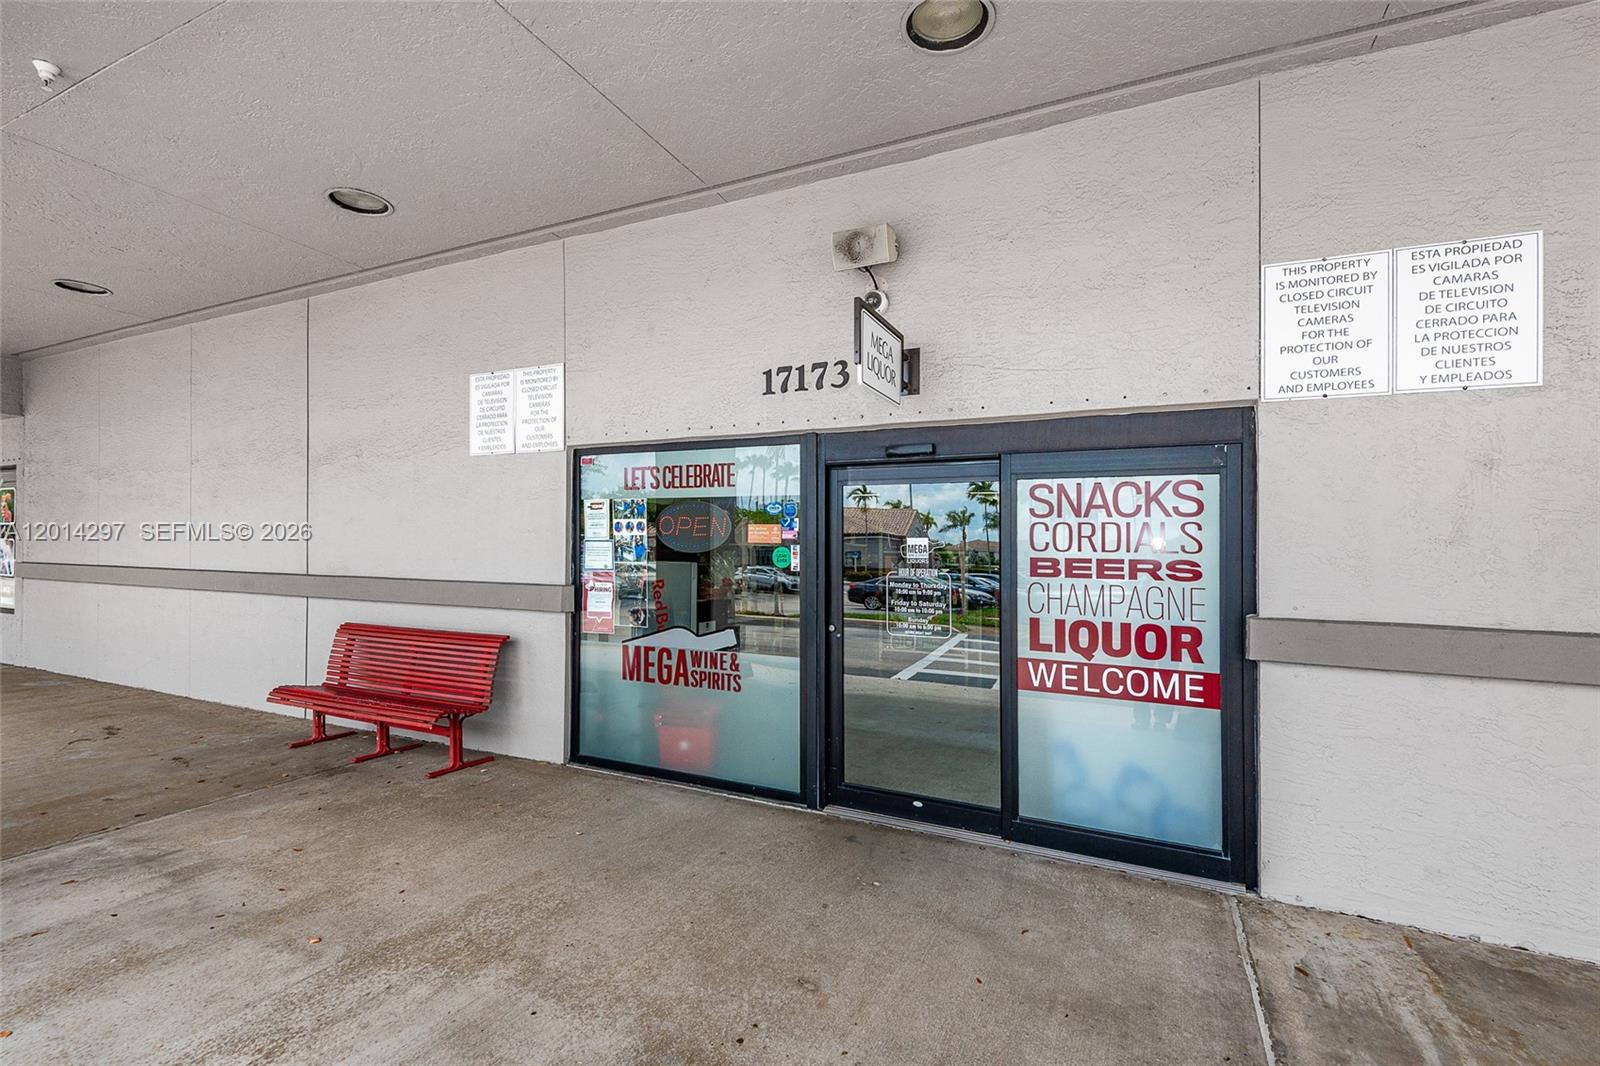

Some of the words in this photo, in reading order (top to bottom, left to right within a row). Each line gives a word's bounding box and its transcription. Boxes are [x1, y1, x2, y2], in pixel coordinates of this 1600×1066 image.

[1411, 249, 1441, 261] ESTA
[1444, 239, 1523, 257] PROPIEDAD
[1282, 266, 1307, 277] THIS
[1310, 258, 1371, 274] PROPERTY
[1411, 264, 1426, 275] ES
[1428, 257, 1491, 273] VIGILADA
[1494, 253, 1523, 265] POR
[1275, 281, 1285, 291] IS
[1288, 273, 1360, 290] MONITORED
[1362, 270, 1378, 281] BY
[1432, 270, 1499, 286] CAMARAS
[1279, 290, 1324, 303] CLOSED
[1327, 284, 1374, 298] CIRCUIT
[1419, 290, 1436, 301] DE
[1438, 282, 1514, 300] TELEVISION
[1294, 299, 1360, 315] TELEVISION
[1424, 304, 1442, 315] DE
[1445, 298, 1508, 312] CIRCUITO
[1297, 313, 1355, 328] CAMERAS
[1415, 315, 1479, 329] CERRADO
[1482, 311, 1518, 324] PARA
[1301, 329, 1325, 340] FOR
[1327, 327, 1350, 338] THE
[1414, 333, 1430, 343] LA
[1433, 326, 1519, 342] PROTECCION
[871, 331, 894, 364] MEGA
[1280, 341, 1353, 355] PROTECTION
[1356, 338, 1373, 349] OF
[1420, 346, 1438, 357] DE
[1441, 340, 1512, 356] NUESTROS
[867, 352, 897, 387] LIQUOR
[1312, 355, 1339, 366] OUR
[1434, 356, 1496, 370] CLIENTES
[762, 360, 850, 396] 17173
[1290, 366, 1362, 381] CUSTOMERS
[1419, 375, 1428, 385] Y
[1431, 369, 1513, 384] EMPLEADOS
[1278, 384, 1304, 394] AND
[1306, 379, 1375, 393] EMPLOYEES
[623, 465, 660, 490] LET'S
[662, 462, 736, 490] CELEBRATE
[1028, 479, 1205, 519] SNACKS
[658, 514, 727, 537] OPEN
[1028, 521, 1204, 555] CORDIALS
[907, 544, 928, 554] MEGA
[1029, 557, 1204, 582] BEERS
[920, 582, 947, 590] Thursday
[919, 600, 947, 609] Saturday
[1027, 581, 1207, 622] CHAMPAGNE
[908, 616, 929, 625] Sunday
[1029, 617, 1205, 664] LIQUOR
[622, 644, 690, 688] MEGA
[690, 650, 728, 671] WINE
[729, 652, 740, 673] &
[690, 670, 742, 693] SPIRITS
[1027, 661, 1205, 703] WELCOME
